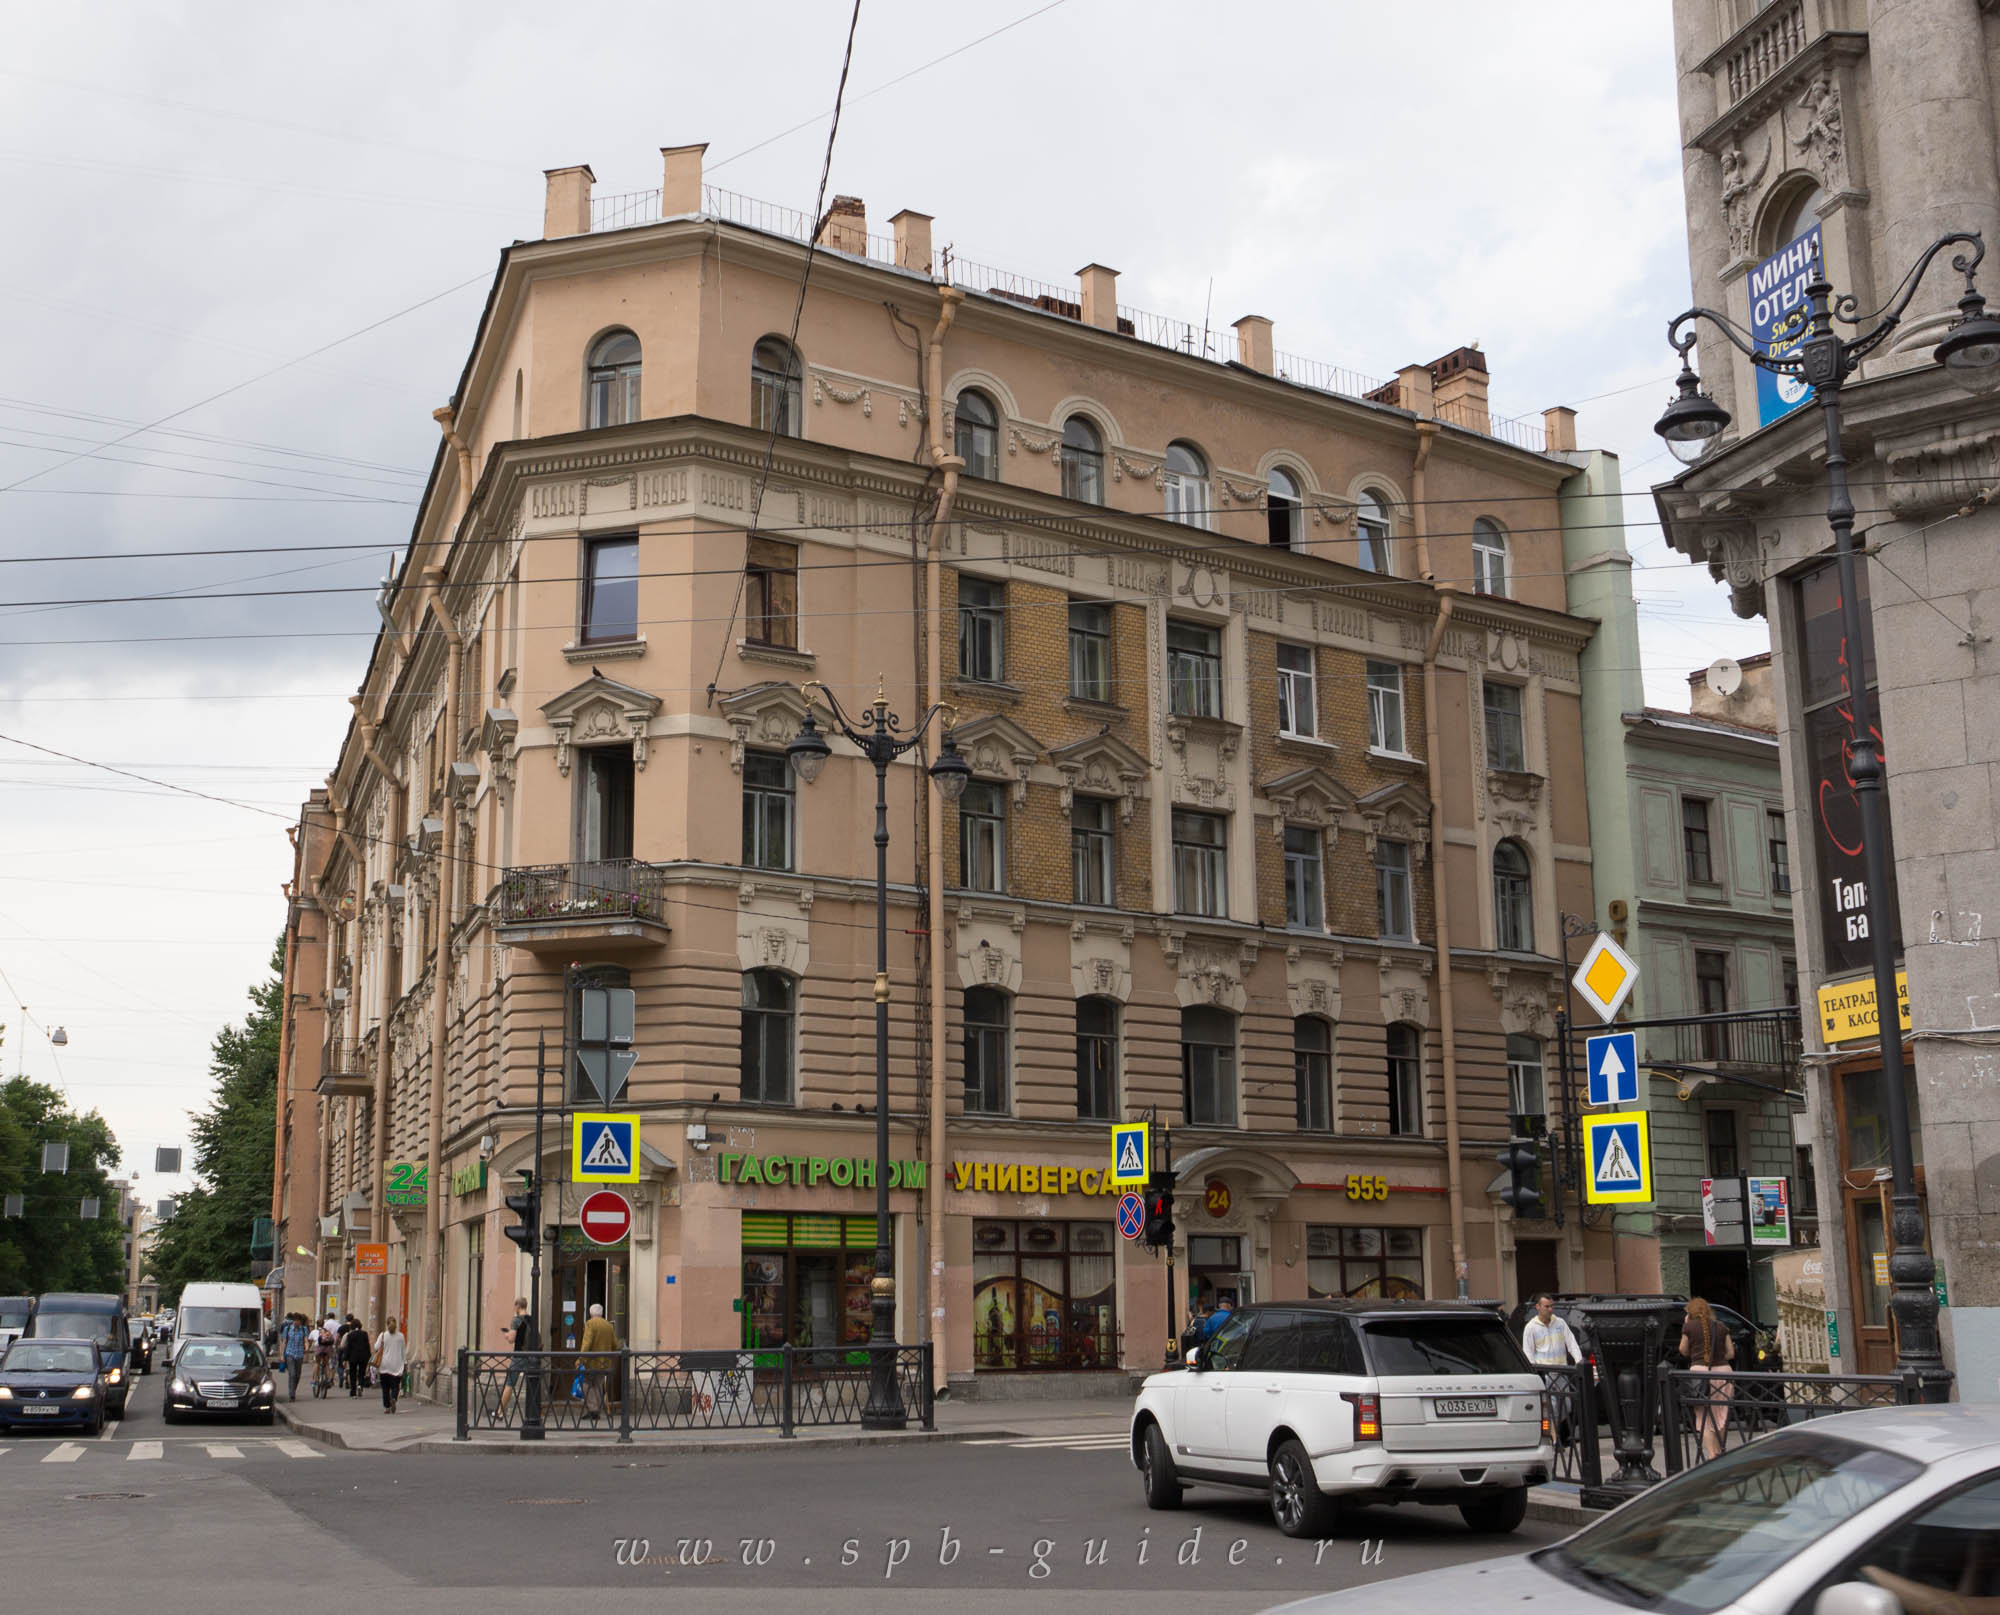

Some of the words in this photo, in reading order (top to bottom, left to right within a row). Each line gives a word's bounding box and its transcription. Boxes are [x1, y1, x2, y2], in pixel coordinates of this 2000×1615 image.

[1752, 231, 1820, 298] МИНИ
[1832, 877, 1868, 912] Тап
[1824, 984, 1908, 1013] ТЕАТРАЛЯ
[1848, 1010, 1880, 1028] КАСС
[1208, 1190, 1229, 1209] 24
[1346, 1175, 1389, 1201] 555
